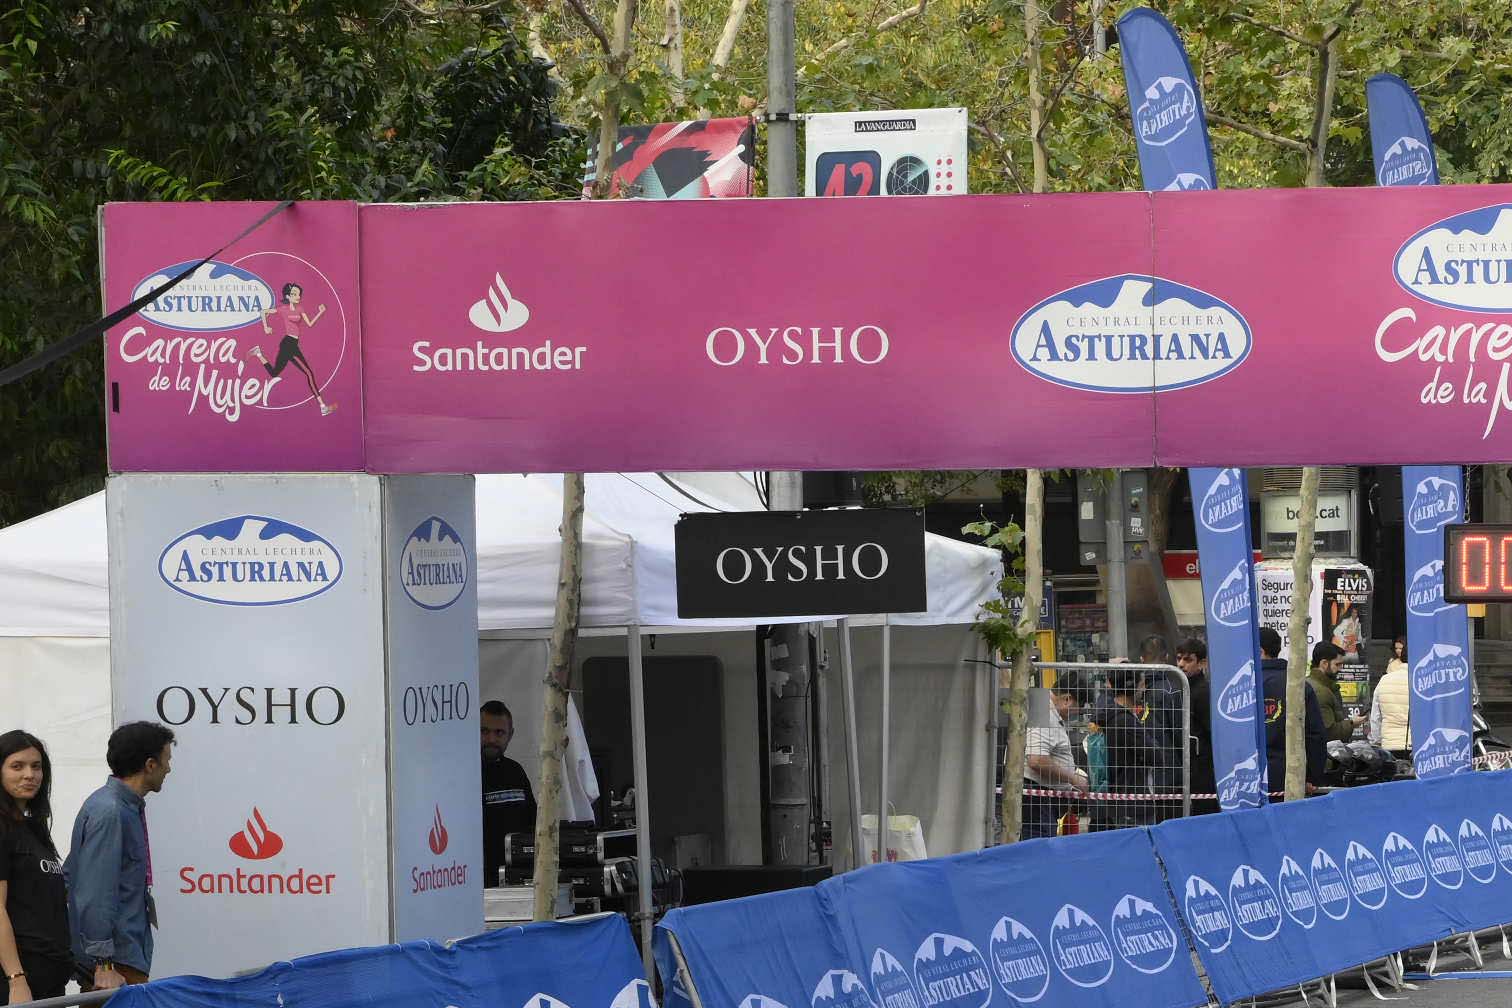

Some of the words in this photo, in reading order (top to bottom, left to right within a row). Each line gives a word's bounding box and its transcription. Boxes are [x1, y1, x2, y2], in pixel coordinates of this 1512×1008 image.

[143, 286, 265, 313] ASTURIANA
[1066, 316, 1141, 328] CENTRAL
[1150, 315, 1225, 326] LECHERA
[119, 326, 237, 364] Carrera
[412, 339, 586, 372] Santander
[705, 325, 890, 366] OYSHO
[1028, 319, 1234, 362] ASTURIANA
[149, 365, 170, 391] de
[175, 364, 192, 391] la
[188, 361, 282, 422] Mujer
[1420, 366, 1454, 405] de
[1463, 364, 1487, 405] la
[172, 550, 330, 583] ASTURIANA
[201, 547, 259, 556] CENTRAL
[265, 547, 323, 556] LECHERA
[716, 542, 889, 584] OYSHO
[405, 552, 464, 587] ASTURIANA
[1337, 578, 1367, 591] ELVIS
[1262, 595, 1280, 605] que
[1263, 605, 1293, 622] quiere
[156, 686, 346, 726] OYSHO
[403, 682, 470, 726] OYSHO
[179, 867, 336, 895] Santander
[412, 860, 468, 894] Santander
[1056, 938, 1113, 970] ASTURIANA
[1117, 927, 1174, 957] ASTURIANA
[995, 951, 1047, 984] ASTURIANA
